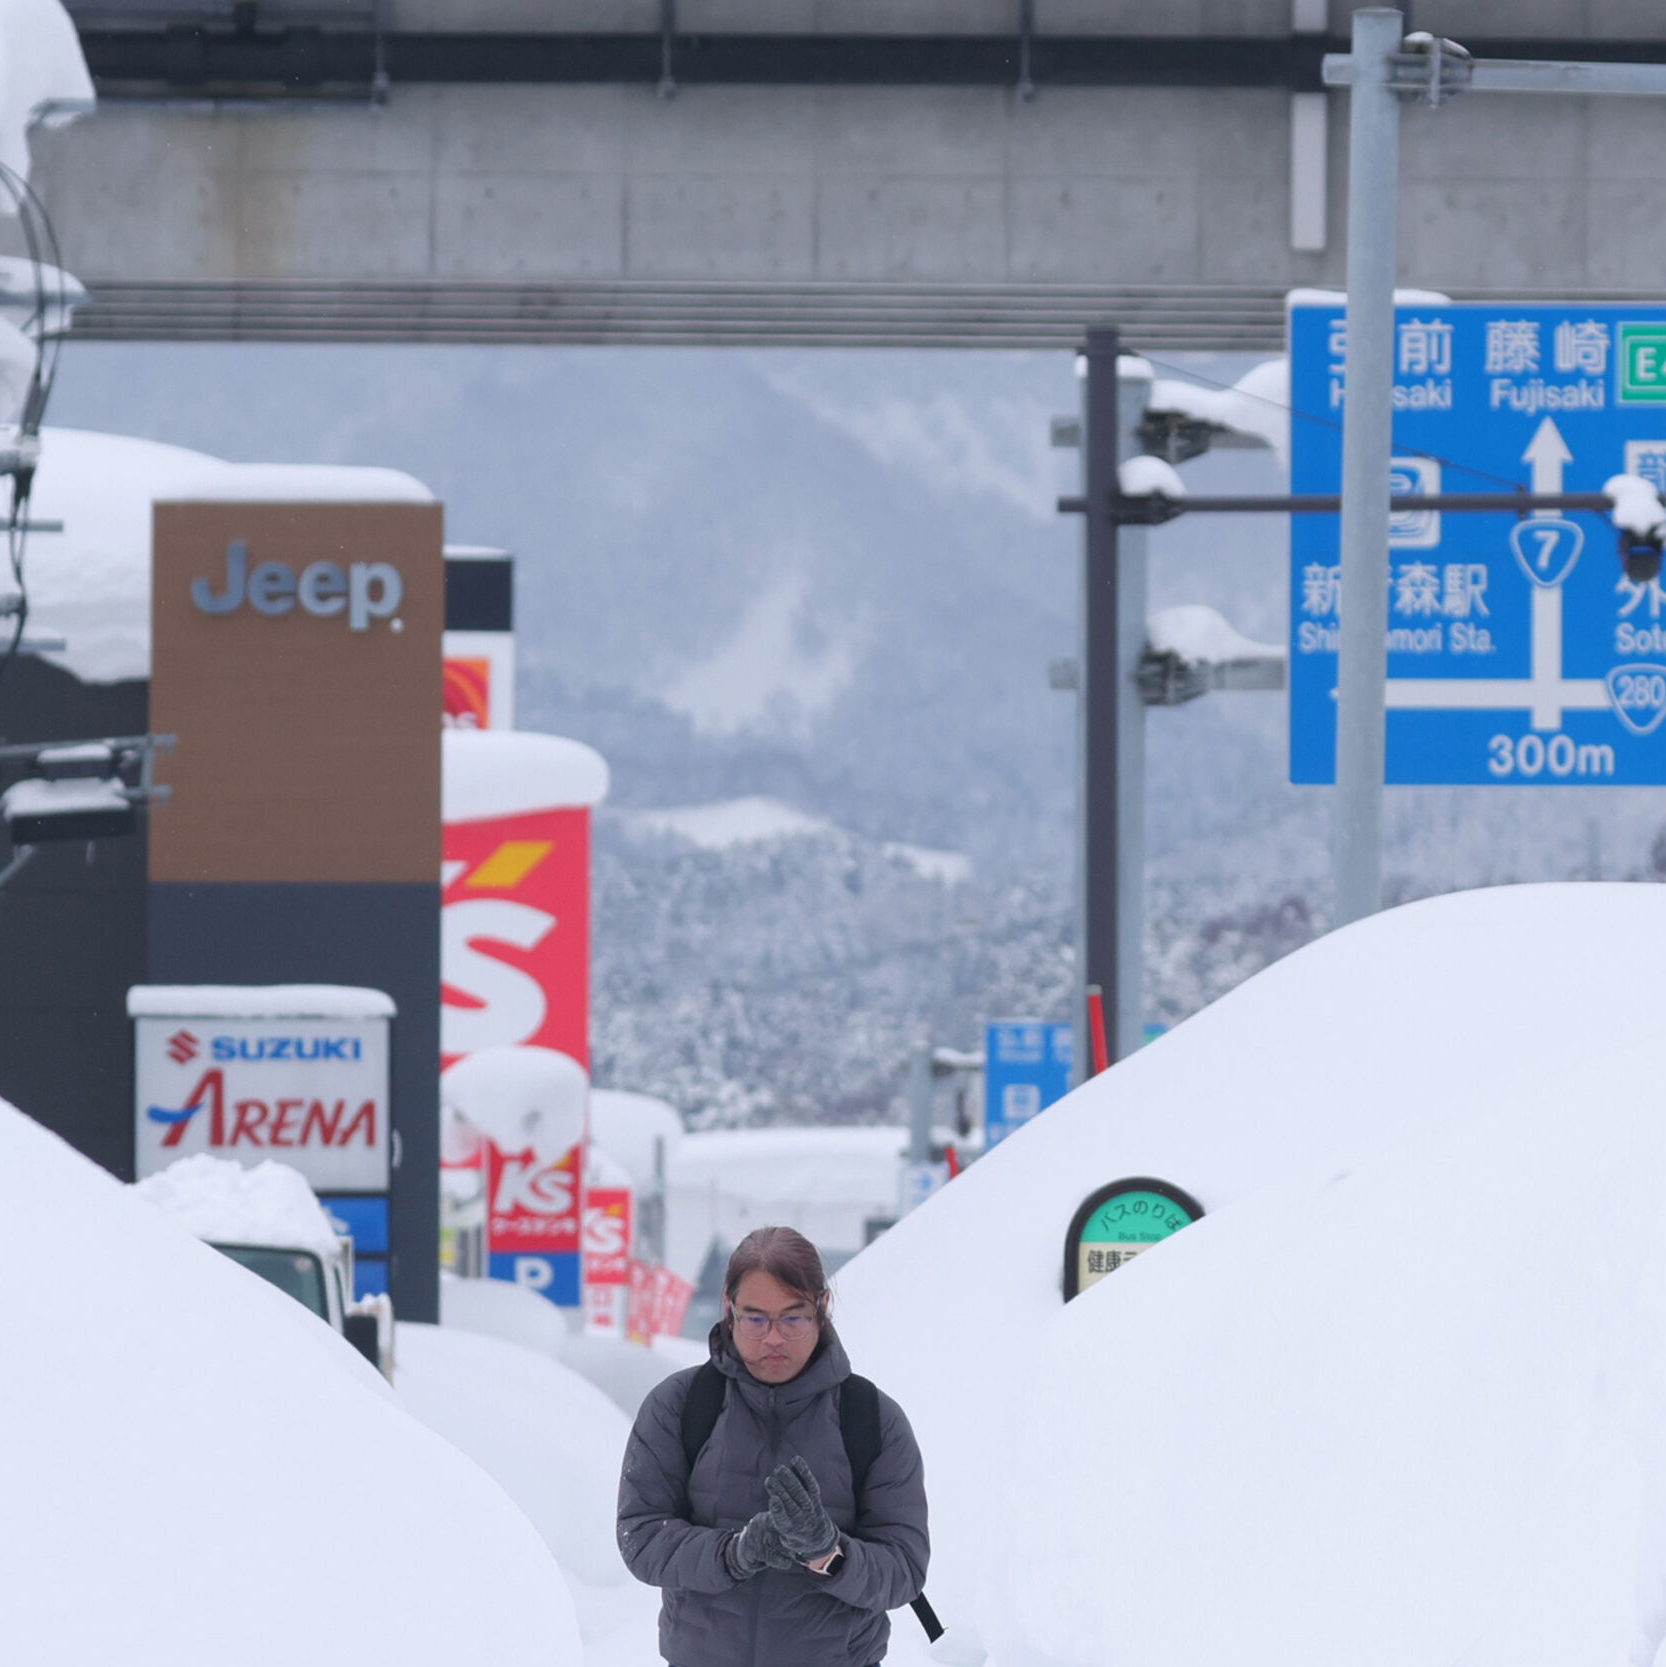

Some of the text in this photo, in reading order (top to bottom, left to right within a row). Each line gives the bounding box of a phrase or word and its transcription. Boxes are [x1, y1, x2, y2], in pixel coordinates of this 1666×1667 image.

[1485, 319, 1611, 375] 藤崎
[1330, 378, 1452, 409] Hsaki
[1490, 378, 1605, 416] Fujisaki
[1534, 529, 1561, 571] 7
[1301, 562, 1490, 617] 新森駅
[1449, 621, 1497, 653] Sta.
[1616, 674, 1666, 707] 280
[1487, 733, 1615, 777] 300m
[210, 1036, 362, 1061] SUZUKI
[155, 1066, 377, 1148] ARENA
[1099, 1200, 1183, 1231] バスのりば
[1118, 1231, 1137, 1241] Bus
[515, 1256, 554, 1290] P
